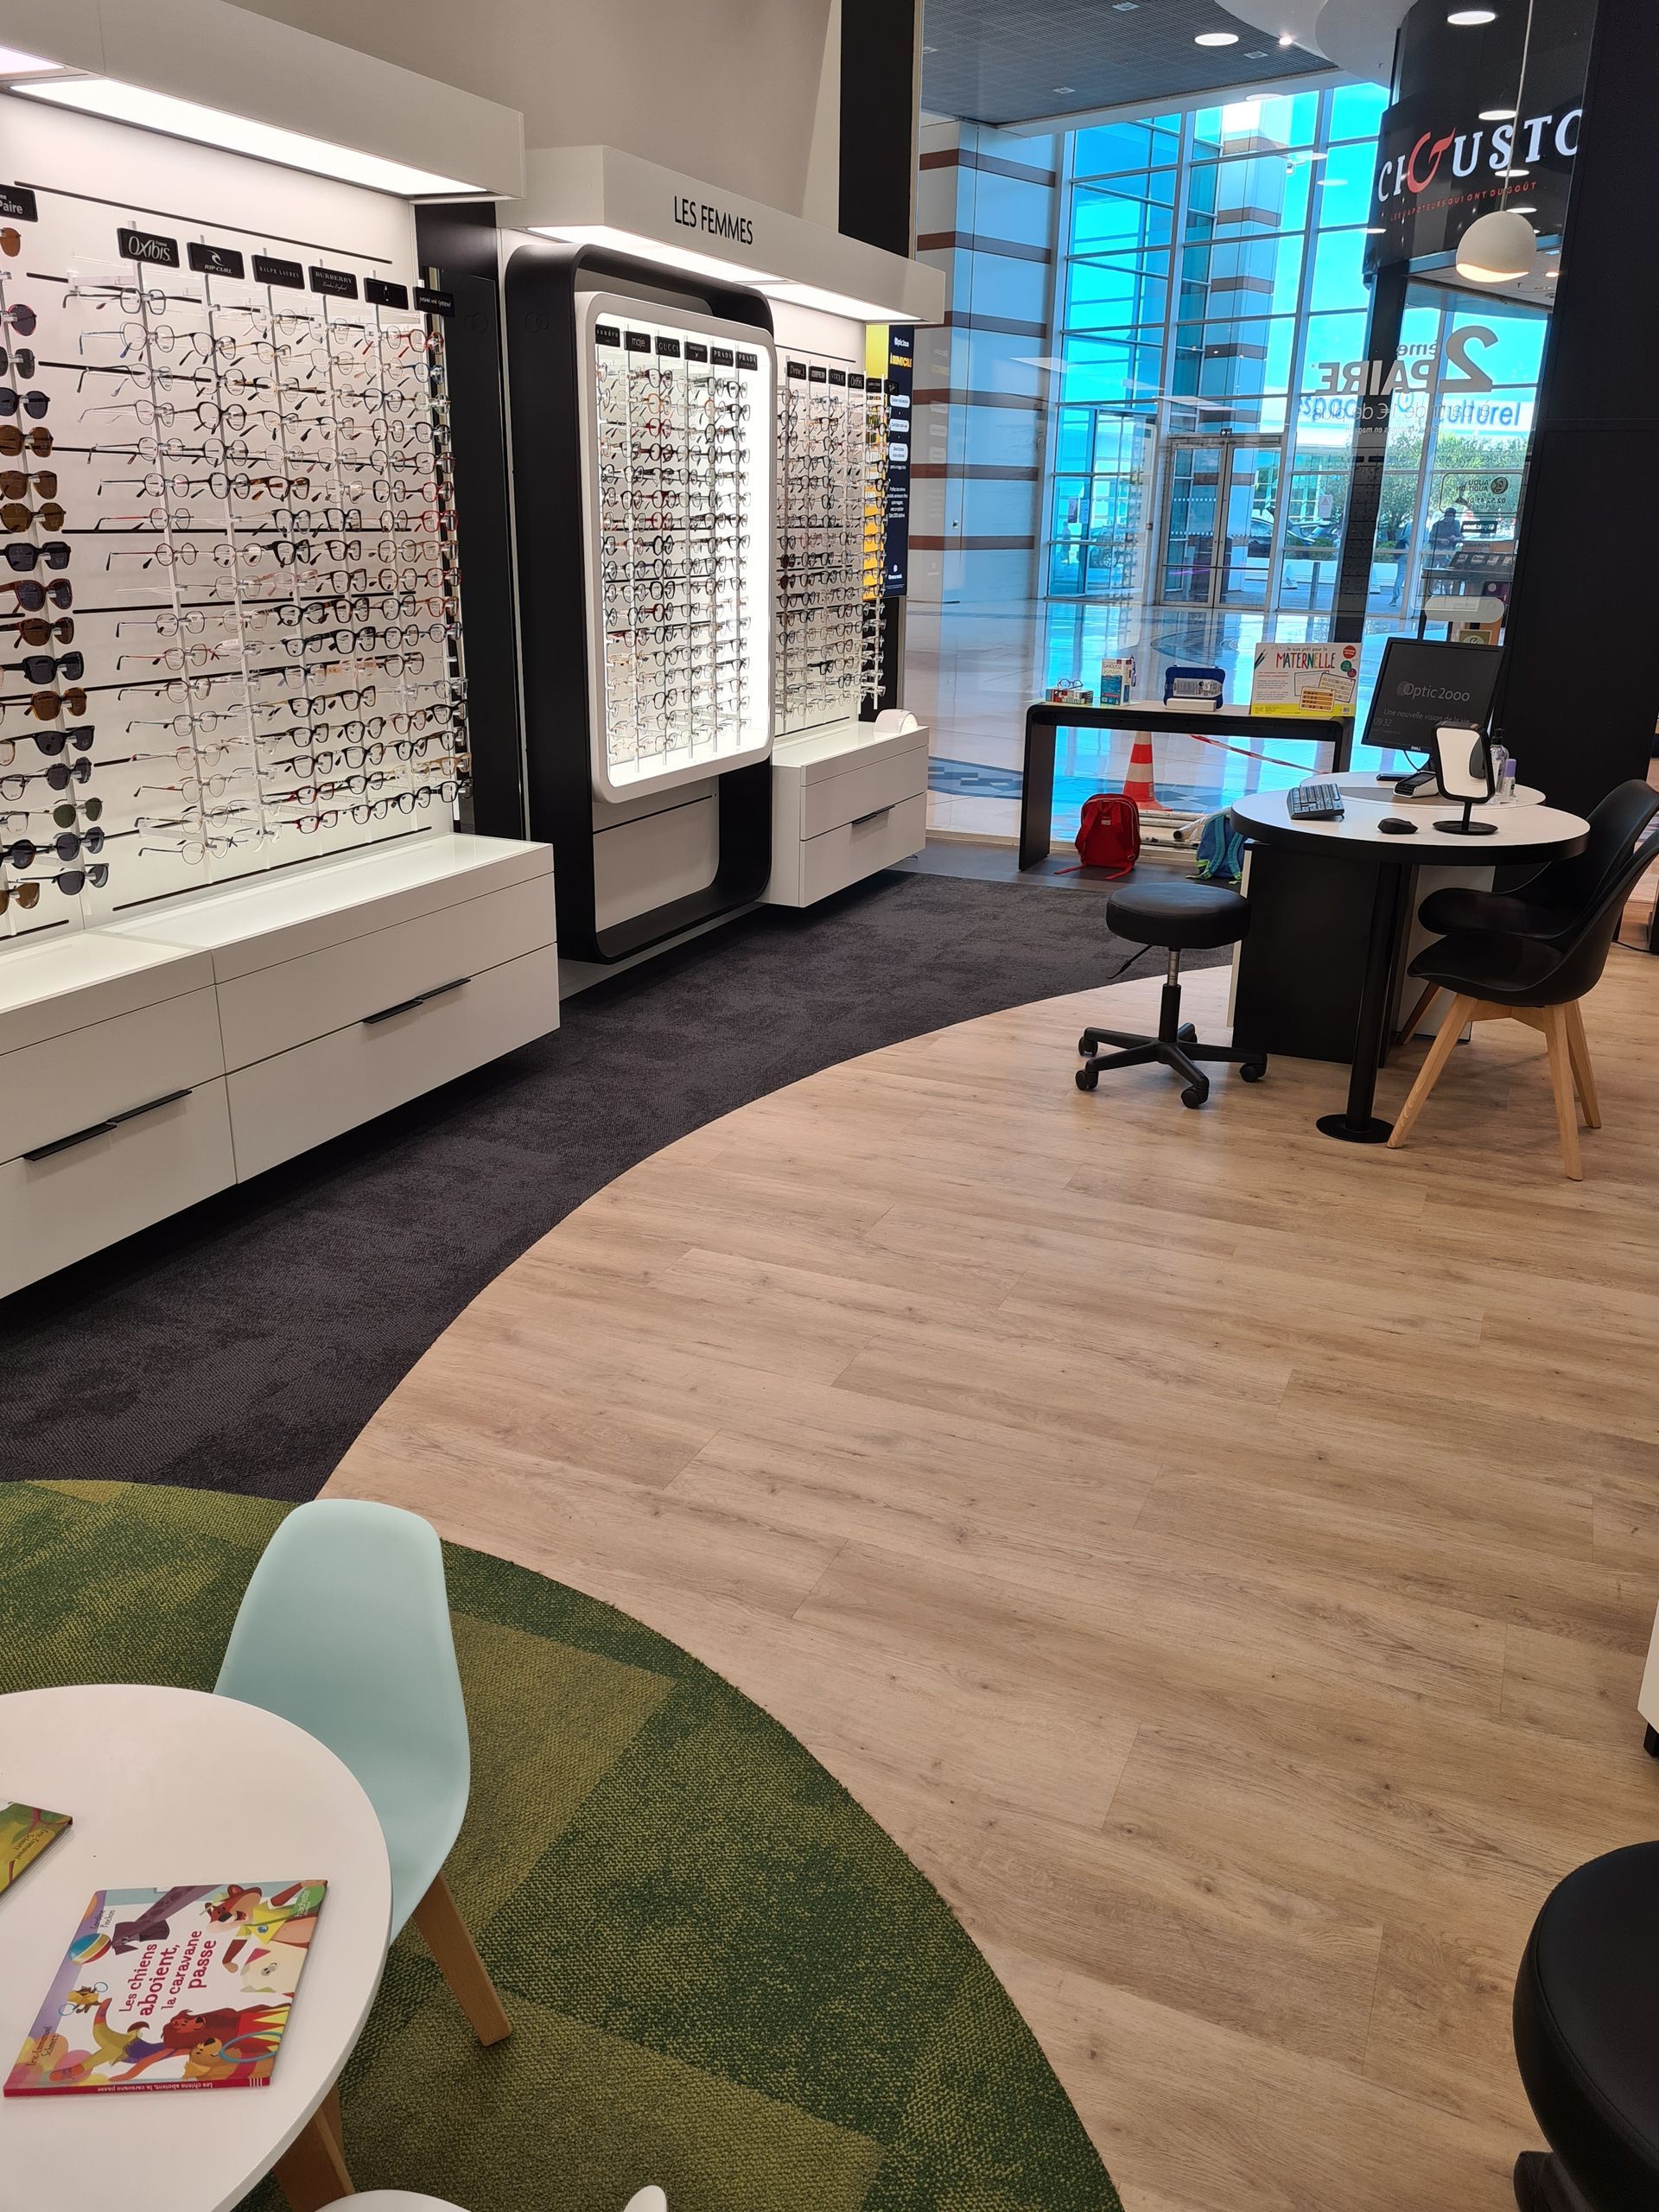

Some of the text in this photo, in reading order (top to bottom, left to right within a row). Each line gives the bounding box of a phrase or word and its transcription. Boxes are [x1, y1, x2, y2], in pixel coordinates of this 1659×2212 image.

[1447, 197, 1464, 207] QUI
[1466, 191, 1487, 202] ONT
[1490, 188, 1503, 198] DU
[1506, 181, 1537, 195] GOÛT
[673, 195, 753, 245] LES FEMMES
[315, 270, 353, 284] BURBERRY
[631, 337, 646, 347] maje
[658, 342, 679, 353] GUCCI
[714, 350, 733, 359] PRADA
[738, 353, 757, 363] PRADA
[1275, 652, 1336, 669] MATERNELLE
[1383, 709, 1395, 717] Une
[1397, 710, 1423, 720] nouvelle
[161, 1929, 202, 2011] la caravane
[188, 1940, 217, 1990] passe
[118, 1943, 157, 2012] Les chiens
[138, 1944, 180, 2016] aboient,
